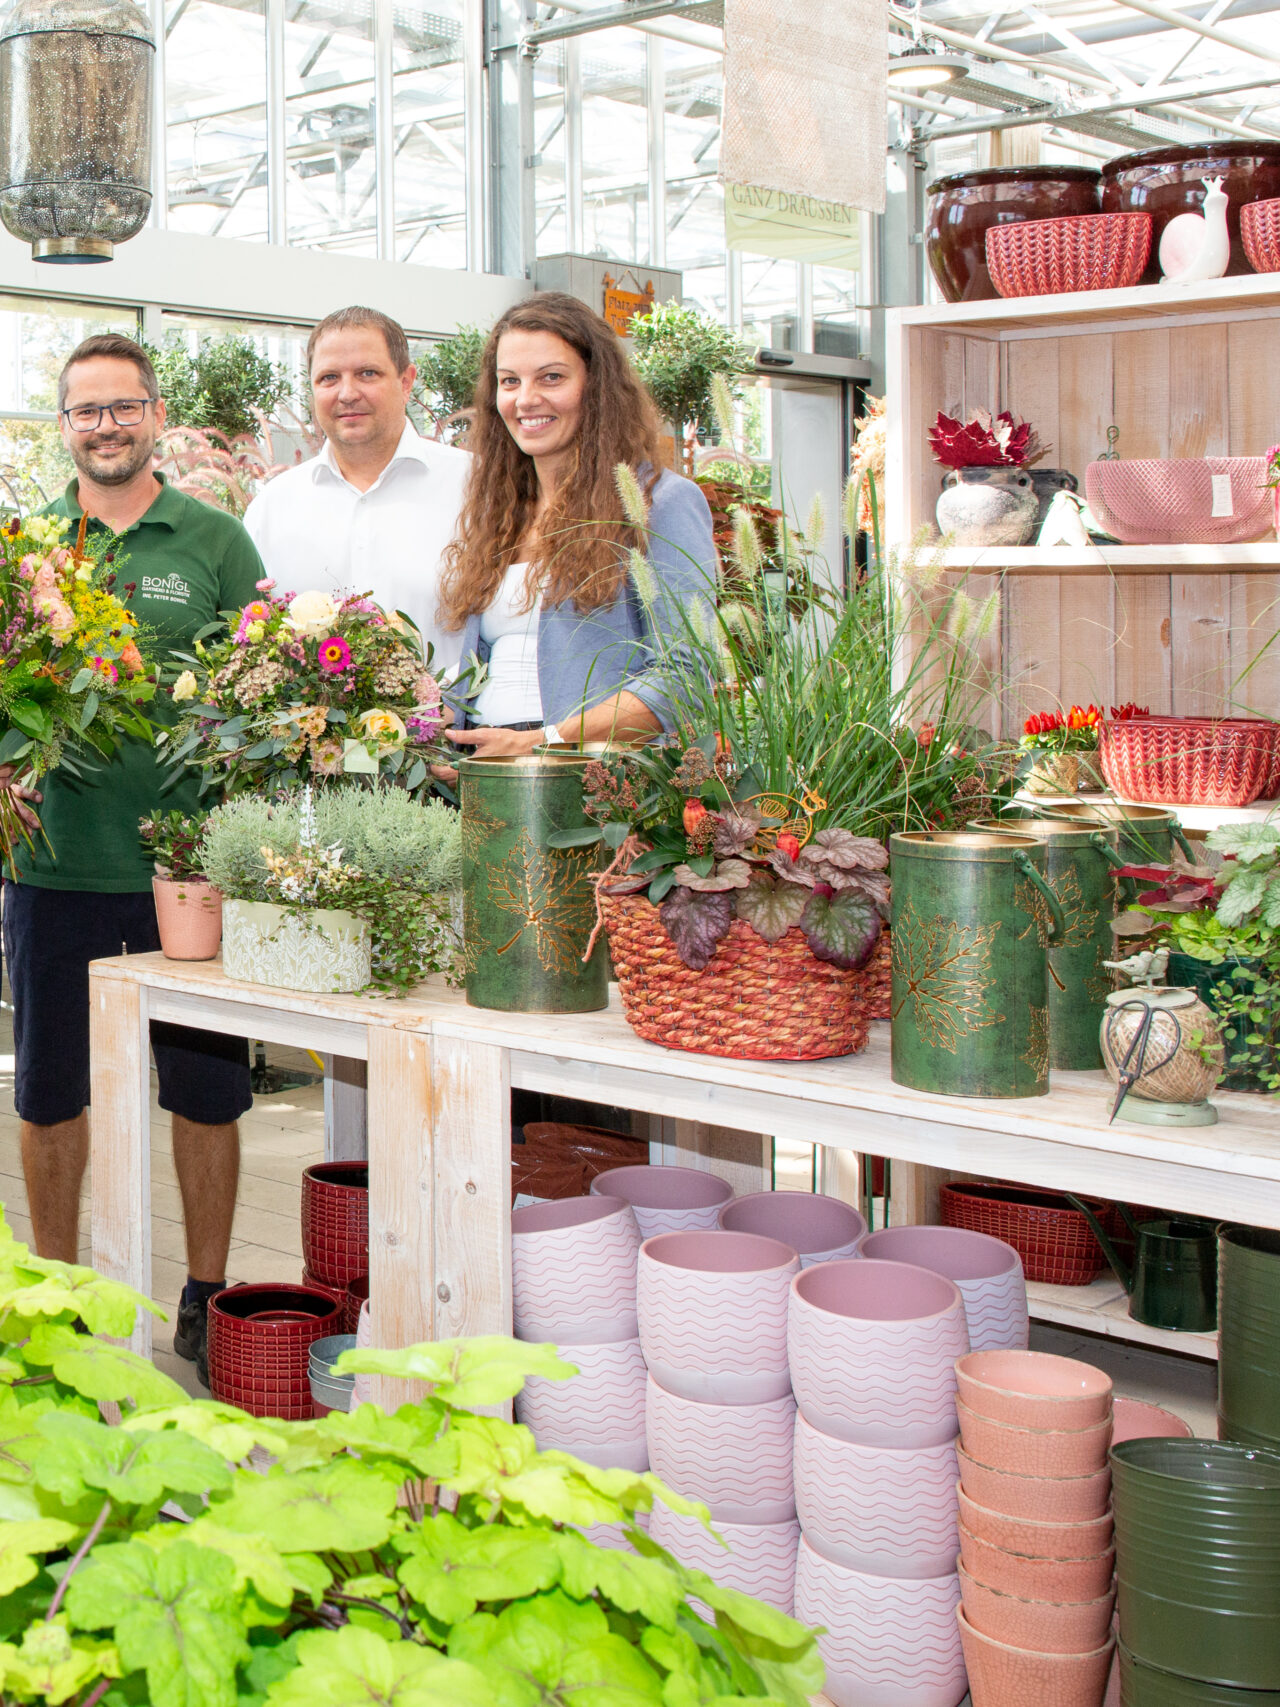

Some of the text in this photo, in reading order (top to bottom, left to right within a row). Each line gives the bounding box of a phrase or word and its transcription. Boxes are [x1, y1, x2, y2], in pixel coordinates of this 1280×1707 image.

[732, 184, 852, 224] GANZ DRAUSSEN
[142, 576, 190, 592] BONIGL
